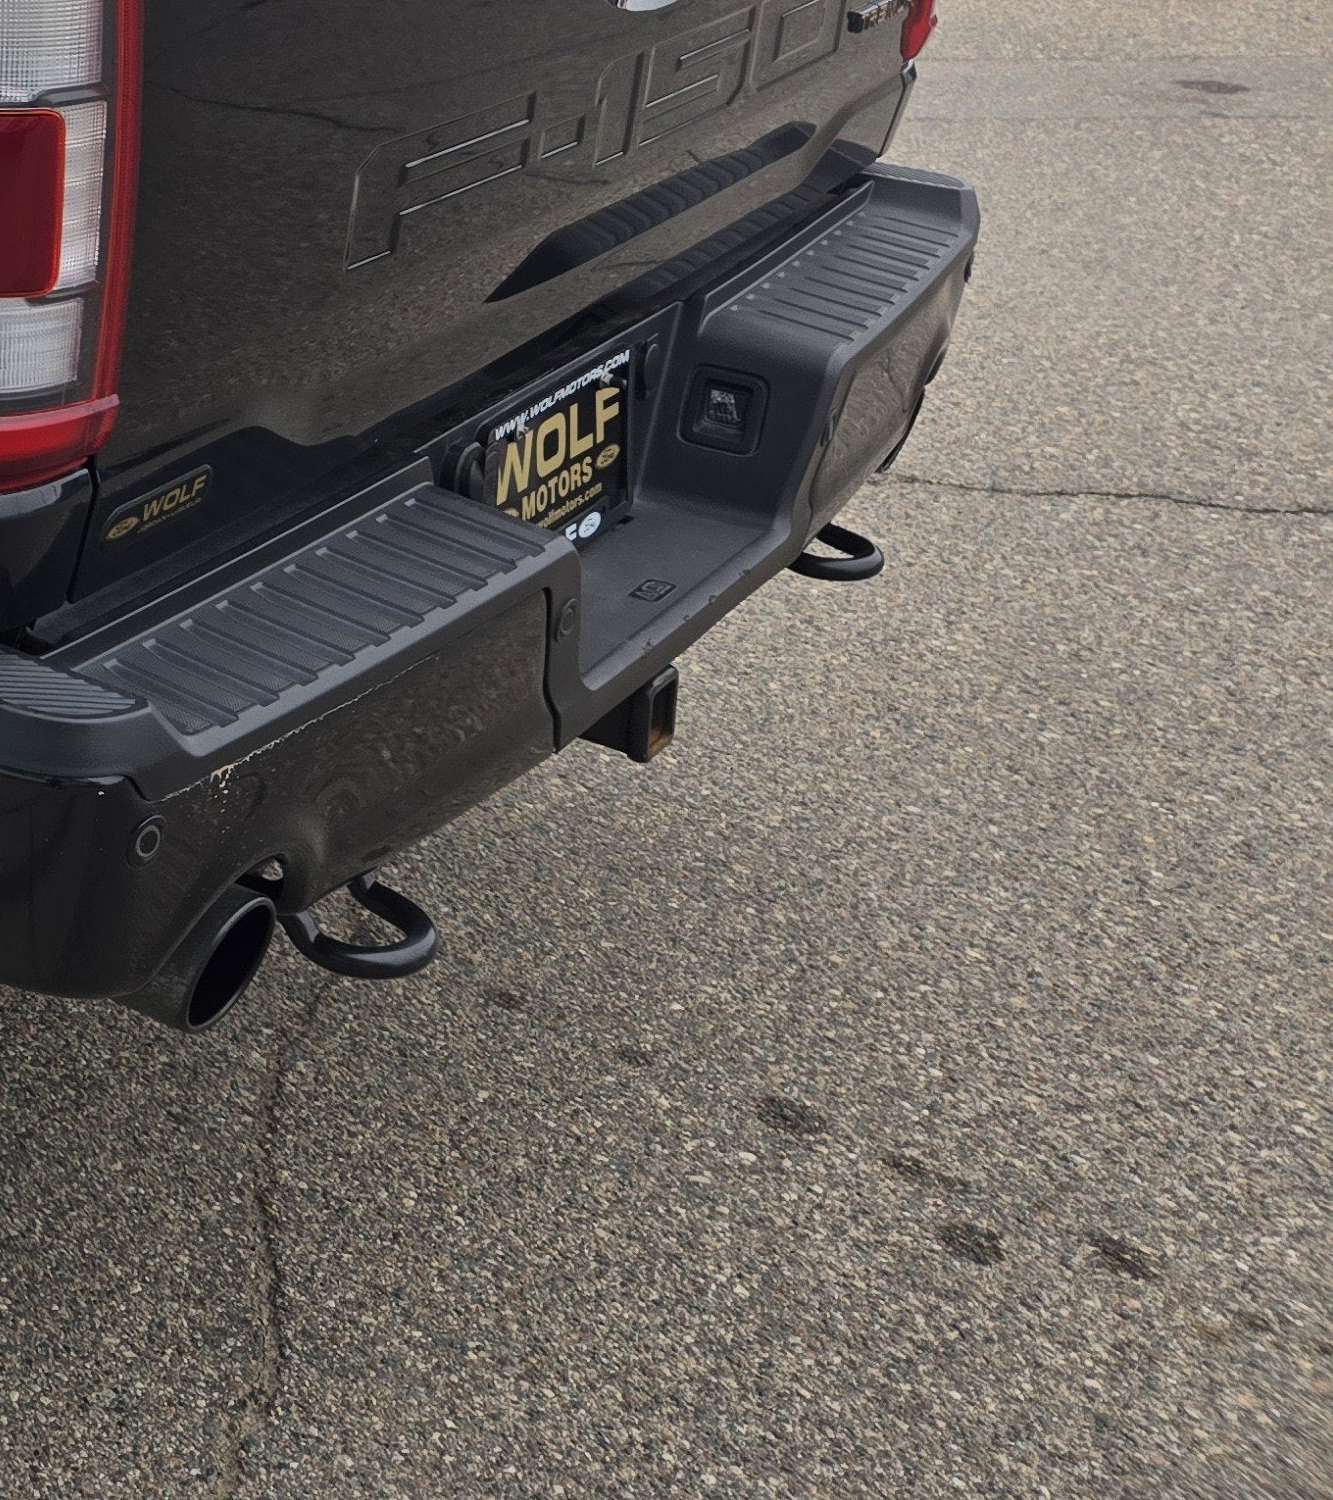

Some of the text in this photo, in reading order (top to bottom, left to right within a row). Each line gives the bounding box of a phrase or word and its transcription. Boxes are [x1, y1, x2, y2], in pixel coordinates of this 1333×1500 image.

[496, 386, 621, 506] WOLF
[143, 474, 207, 521] WOLF
[521, 456, 593, 521] MOTORS
